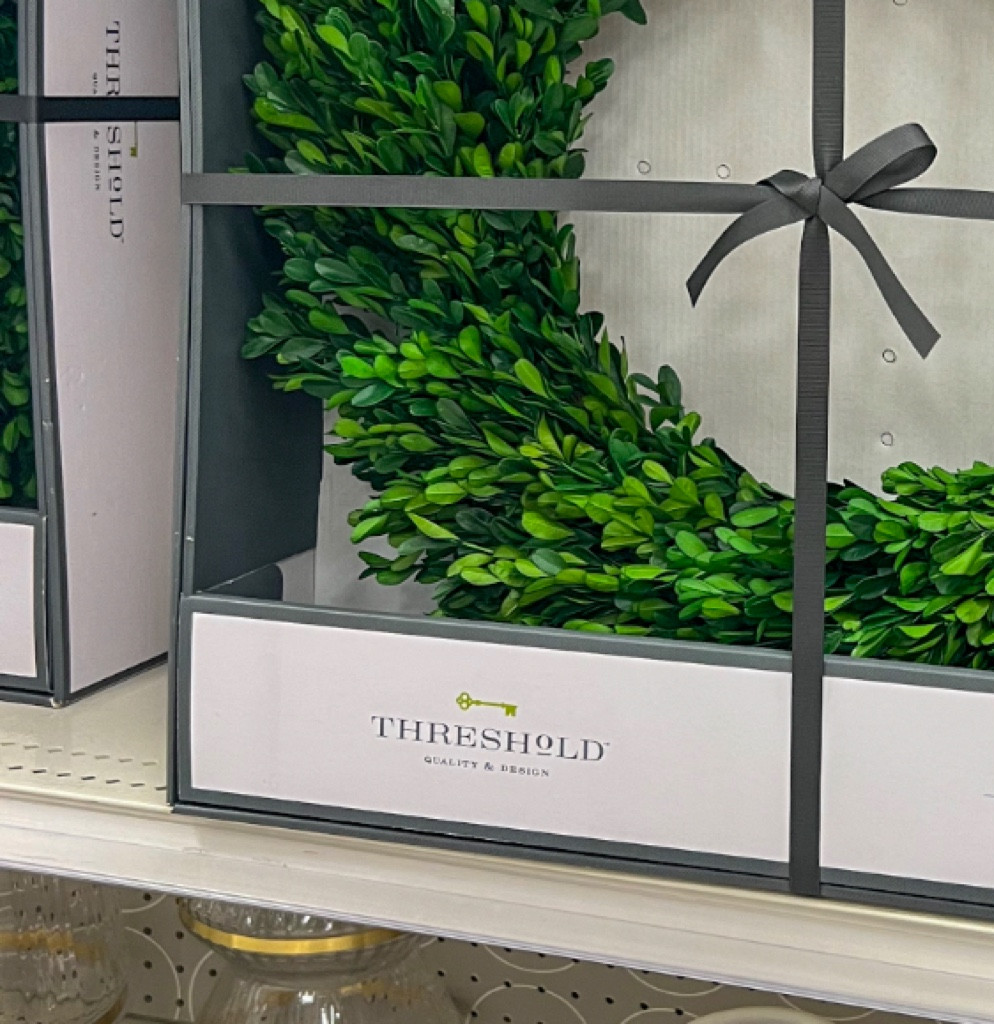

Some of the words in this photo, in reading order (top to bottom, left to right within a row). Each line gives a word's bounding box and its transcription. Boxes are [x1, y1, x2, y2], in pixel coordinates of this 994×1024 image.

[105, 20, 124, 240] THRSHOLD
[424, 756, 478, 769] QUALITY
[484, 761, 494, 771] &
[501, 763, 550, 777] DESIGN
